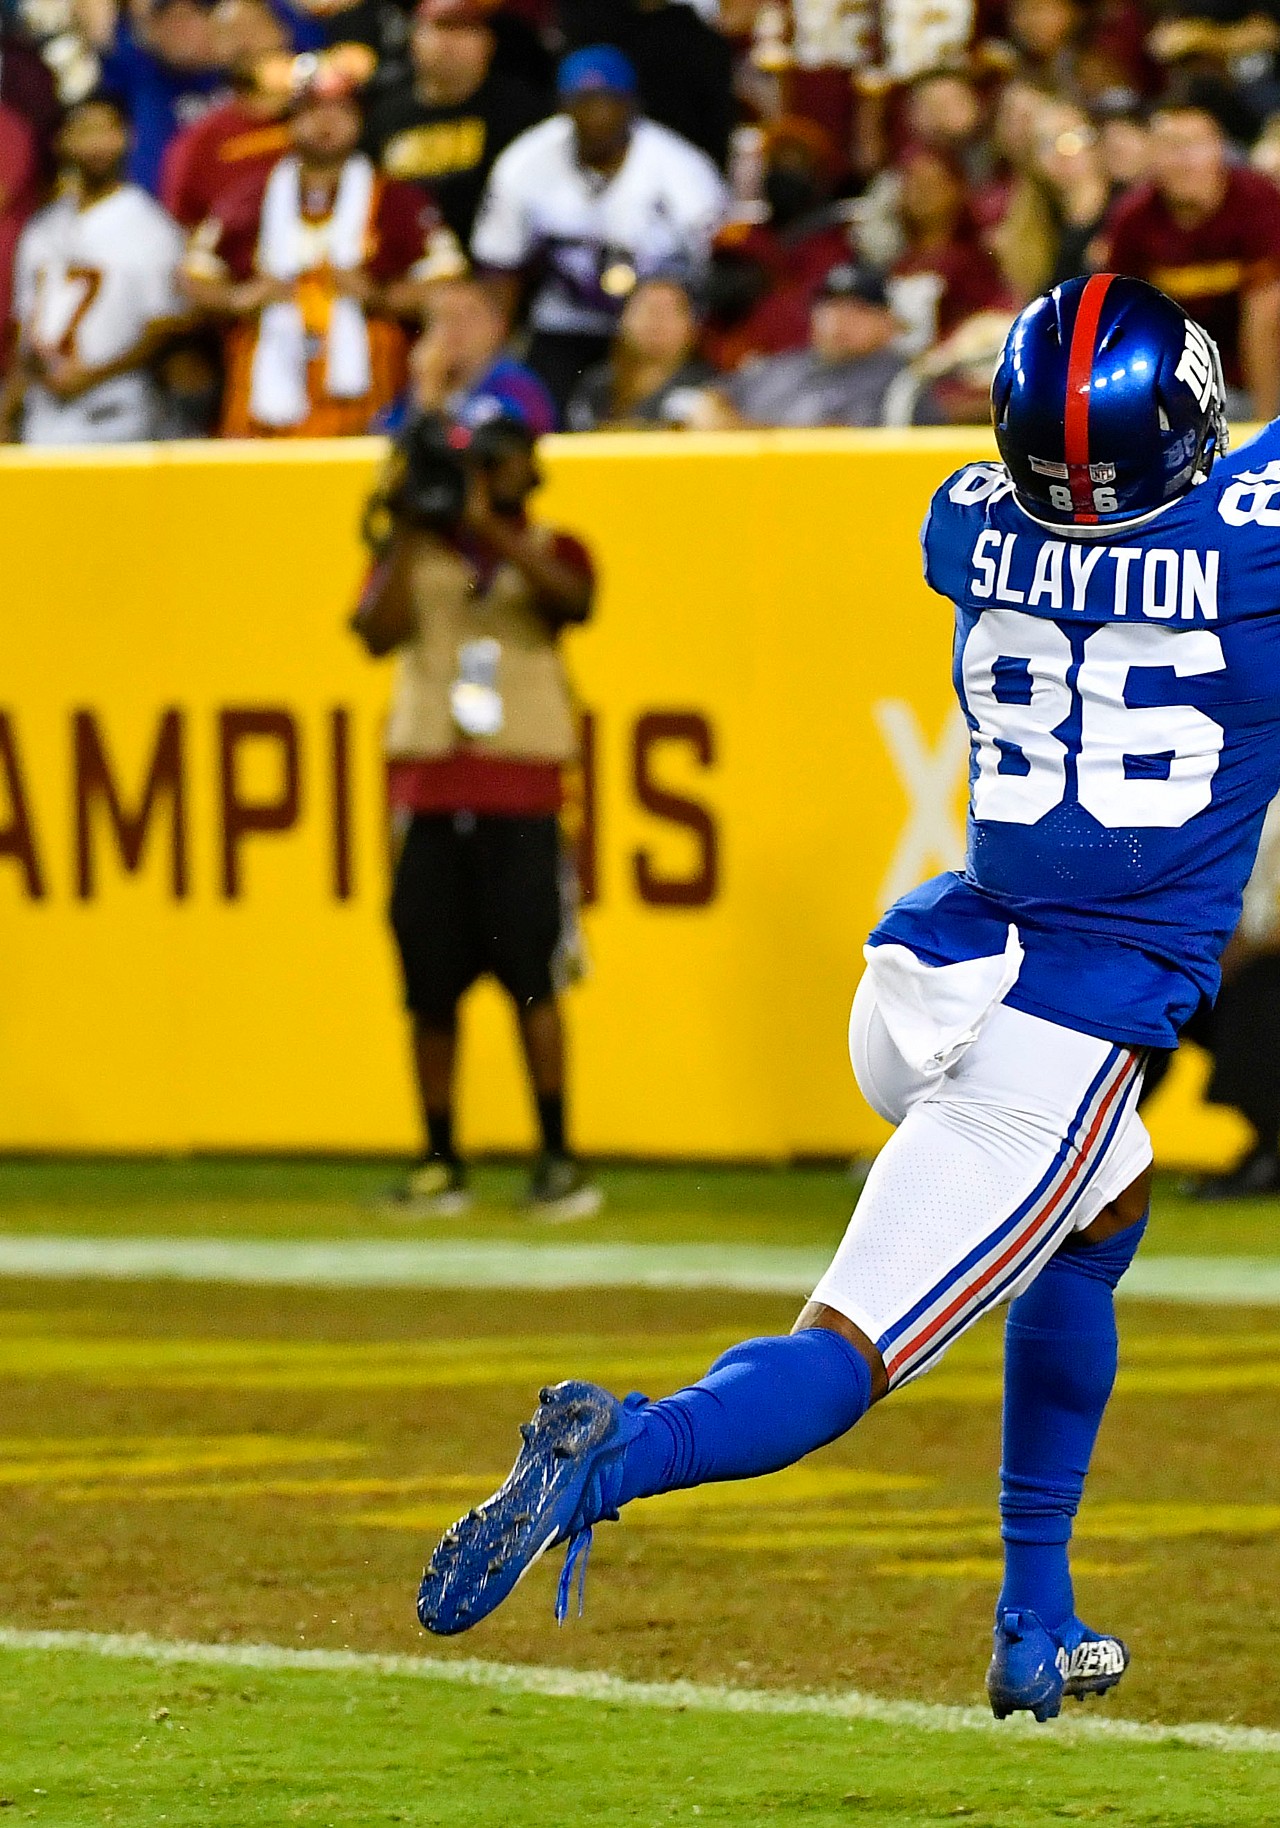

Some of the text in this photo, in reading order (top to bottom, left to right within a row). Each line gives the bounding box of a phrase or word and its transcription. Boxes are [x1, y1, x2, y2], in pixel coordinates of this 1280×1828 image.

[970, 528, 1220, 620] SLAYTON
[0, 706, 721, 910] AMPIS
[961, 608, 1227, 829] 86
